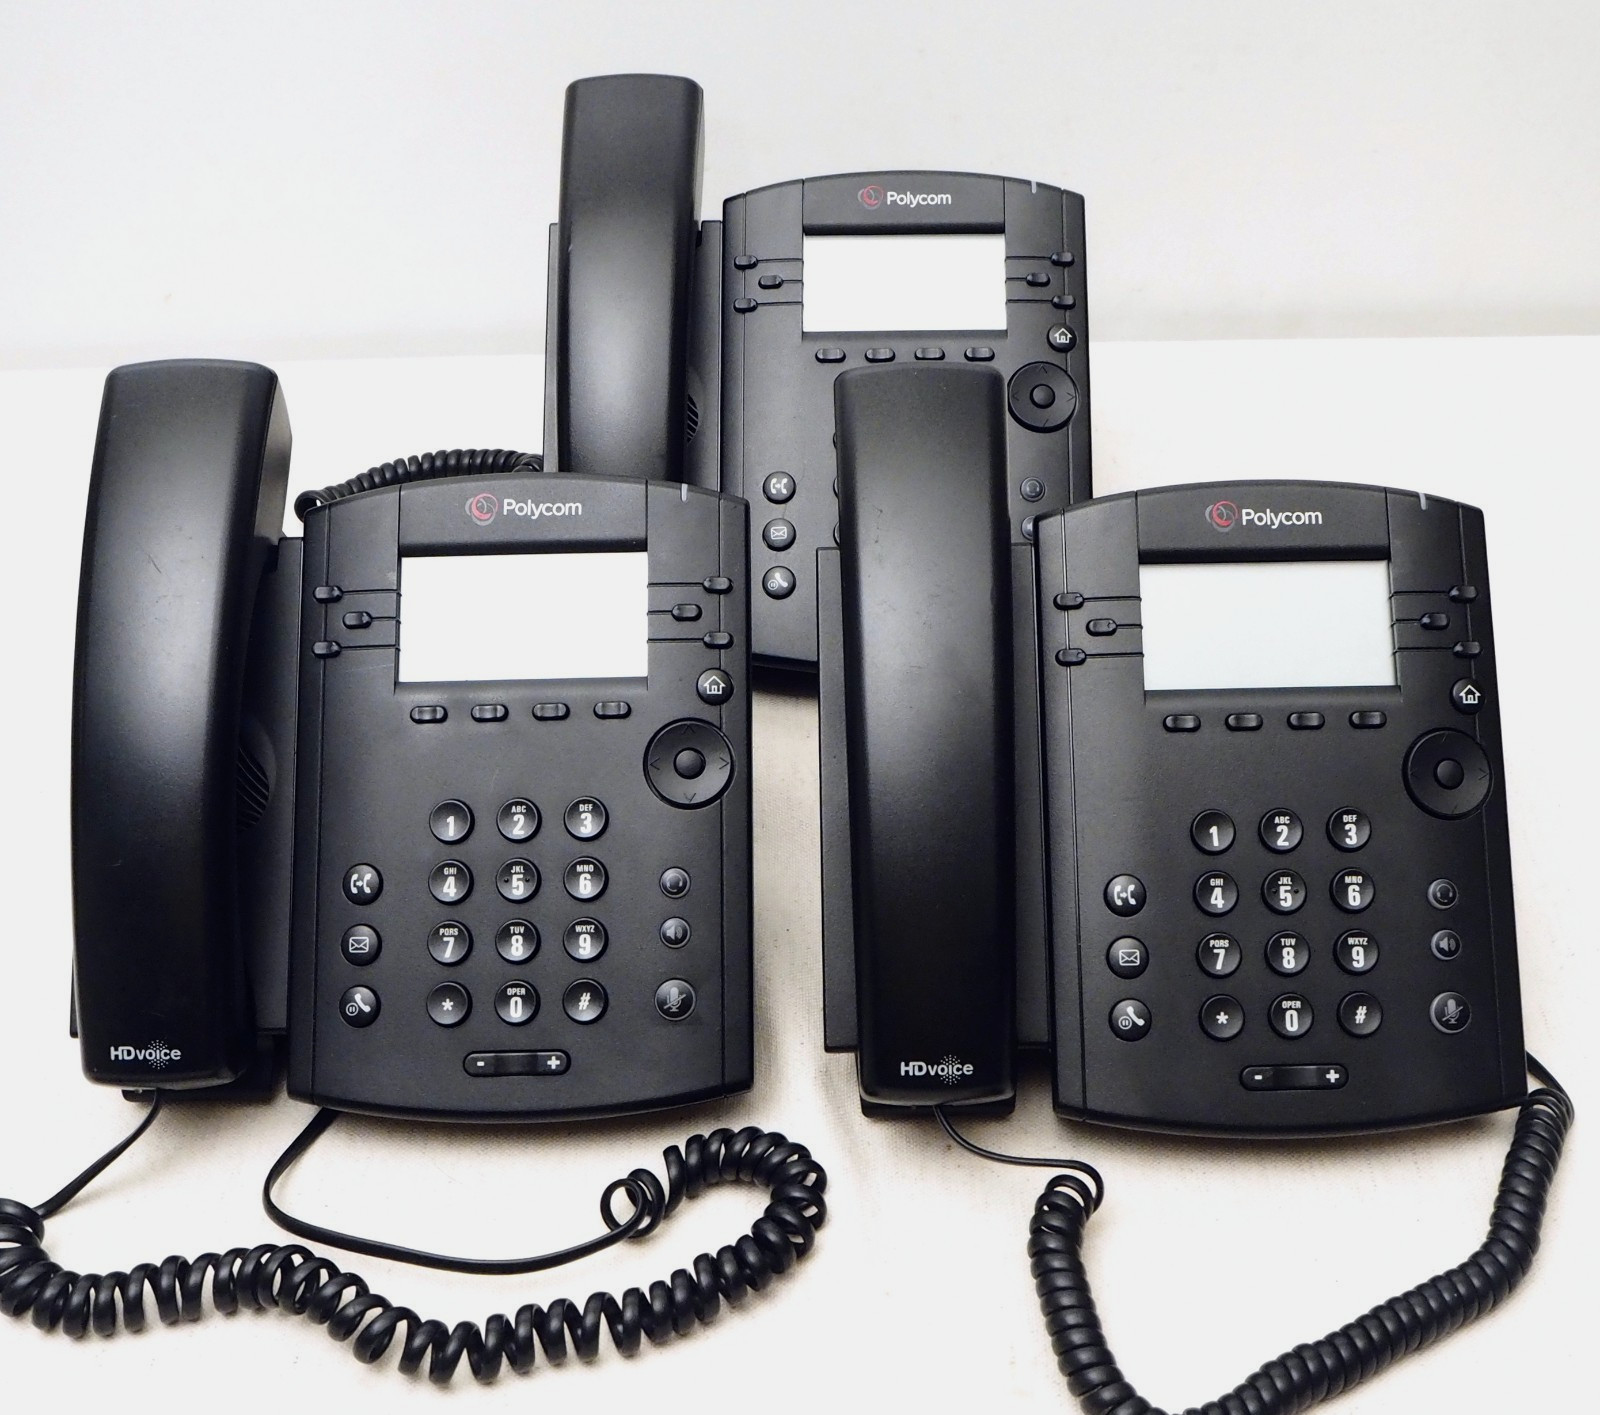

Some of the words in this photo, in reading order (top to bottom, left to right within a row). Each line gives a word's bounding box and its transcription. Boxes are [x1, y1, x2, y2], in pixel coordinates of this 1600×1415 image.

[886, 191, 952, 208] Polycom
[503, 498, 583, 520] Polycom
[1241, 508, 1323, 530] Polycom
[510, 805, 527, 814] ABC
[578, 803, 593, 812] DEF
[1342, 814, 1358, 823] DEF
[445, 815, 456, 838] 1
[511, 814, 526, 836] 2
[579, 812, 593, 835] 3
[1274, 815, 1291, 825] ABC
[1209, 825, 1220, 847] 1
[1276, 824, 1290, 847] 2
[1344, 823, 1358, 846] 3
[443, 867, 457, 876] GHI
[510, 865, 525, 874] JKL
[576, 864, 594, 873] MNO
[1344, 875, 1363, 884] MNO
[442, 876, 458, 898] 4
[511, 874, 525, 897] 5
[578, 873, 592, 896] 6
[1209, 878, 1224, 887] GHI
[1277, 876, 1293, 885] JKL
[1210, 887, 1225, 909] 4
[1279, 885, 1293, 908] 5
[1347, 884, 1362, 907] 6
[509, 925, 525, 934] TUV
[574, 924, 595, 933] WXYZ
[442, 936, 455, 959] 7
[510, 934, 525, 957] 8
[578, 933, 592, 956] 9
[1280, 937, 1297, 947] TUV
[1347, 937, 1368, 946] WXYZ
[1213, 948, 1226, 971] 7
[1282, 947, 1296, 969] 8
[1351, 946, 1365, 969] 9
[506, 987, 526, 996] OPER
[509, 996, 523, 1019] 0
[1281, 1000, 1302, 1009] OPER
[1285, 1009, 1299, 1032] 0
